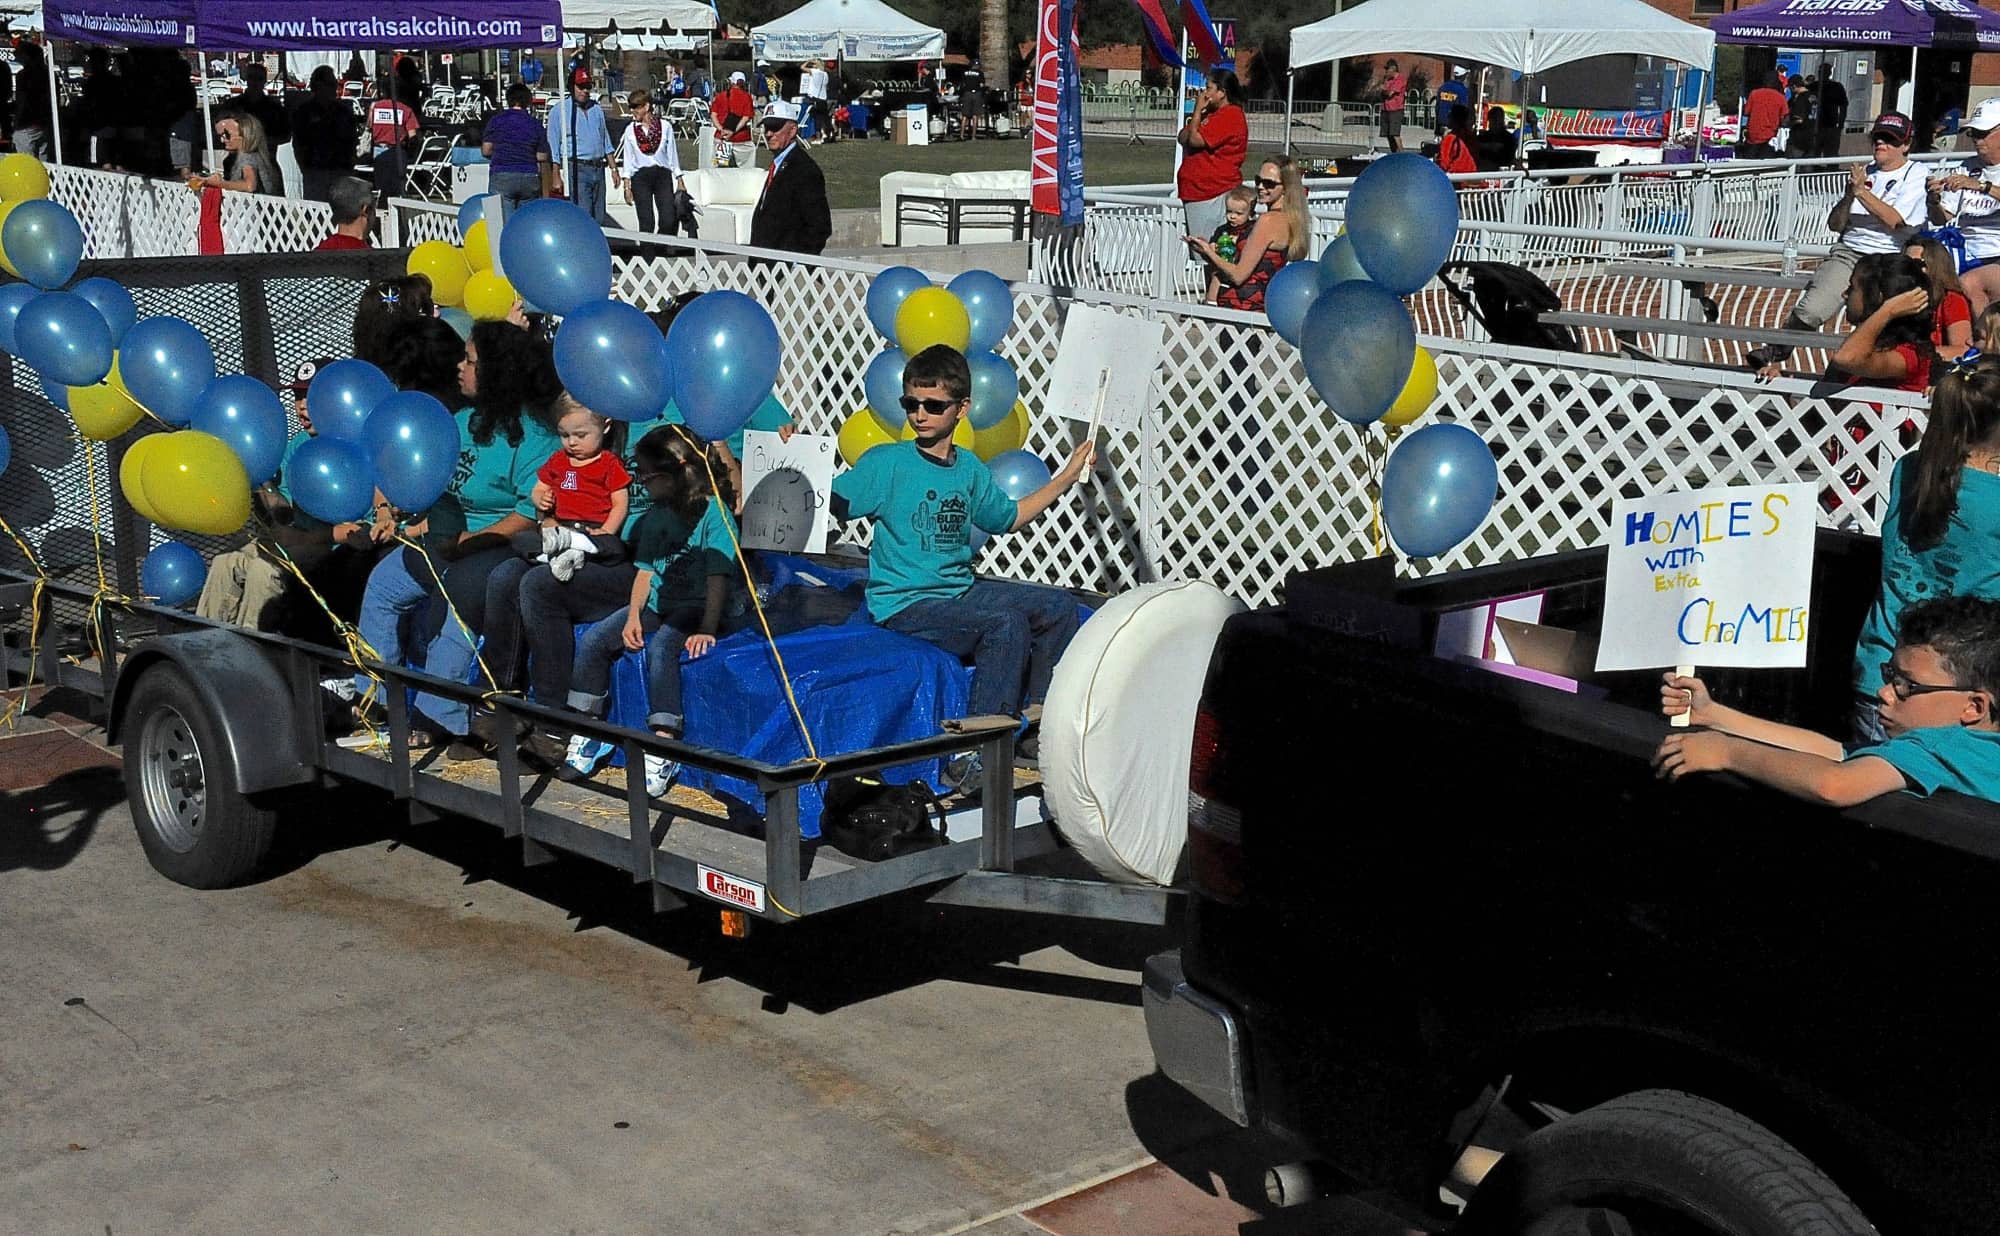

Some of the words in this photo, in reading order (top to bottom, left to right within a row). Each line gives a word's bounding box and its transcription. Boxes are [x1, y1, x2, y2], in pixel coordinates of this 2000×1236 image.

[60, 10, 178, 36] www.harrahsakchin.com
[247, 16, 523, 37] www.harrahsakchin.com
[1731, 25, 1891, 40] www.harrahsakchin.com
[1542, 108, 1617, 136] Italian
[1621, 110, 1658, 137] Ice
[752, 445, 805, 484] Buddy
[561, 471, 578, 490] A
[1625, 493, 1789, 546] HOMIES
[706, 871, 756, 902] Carson
